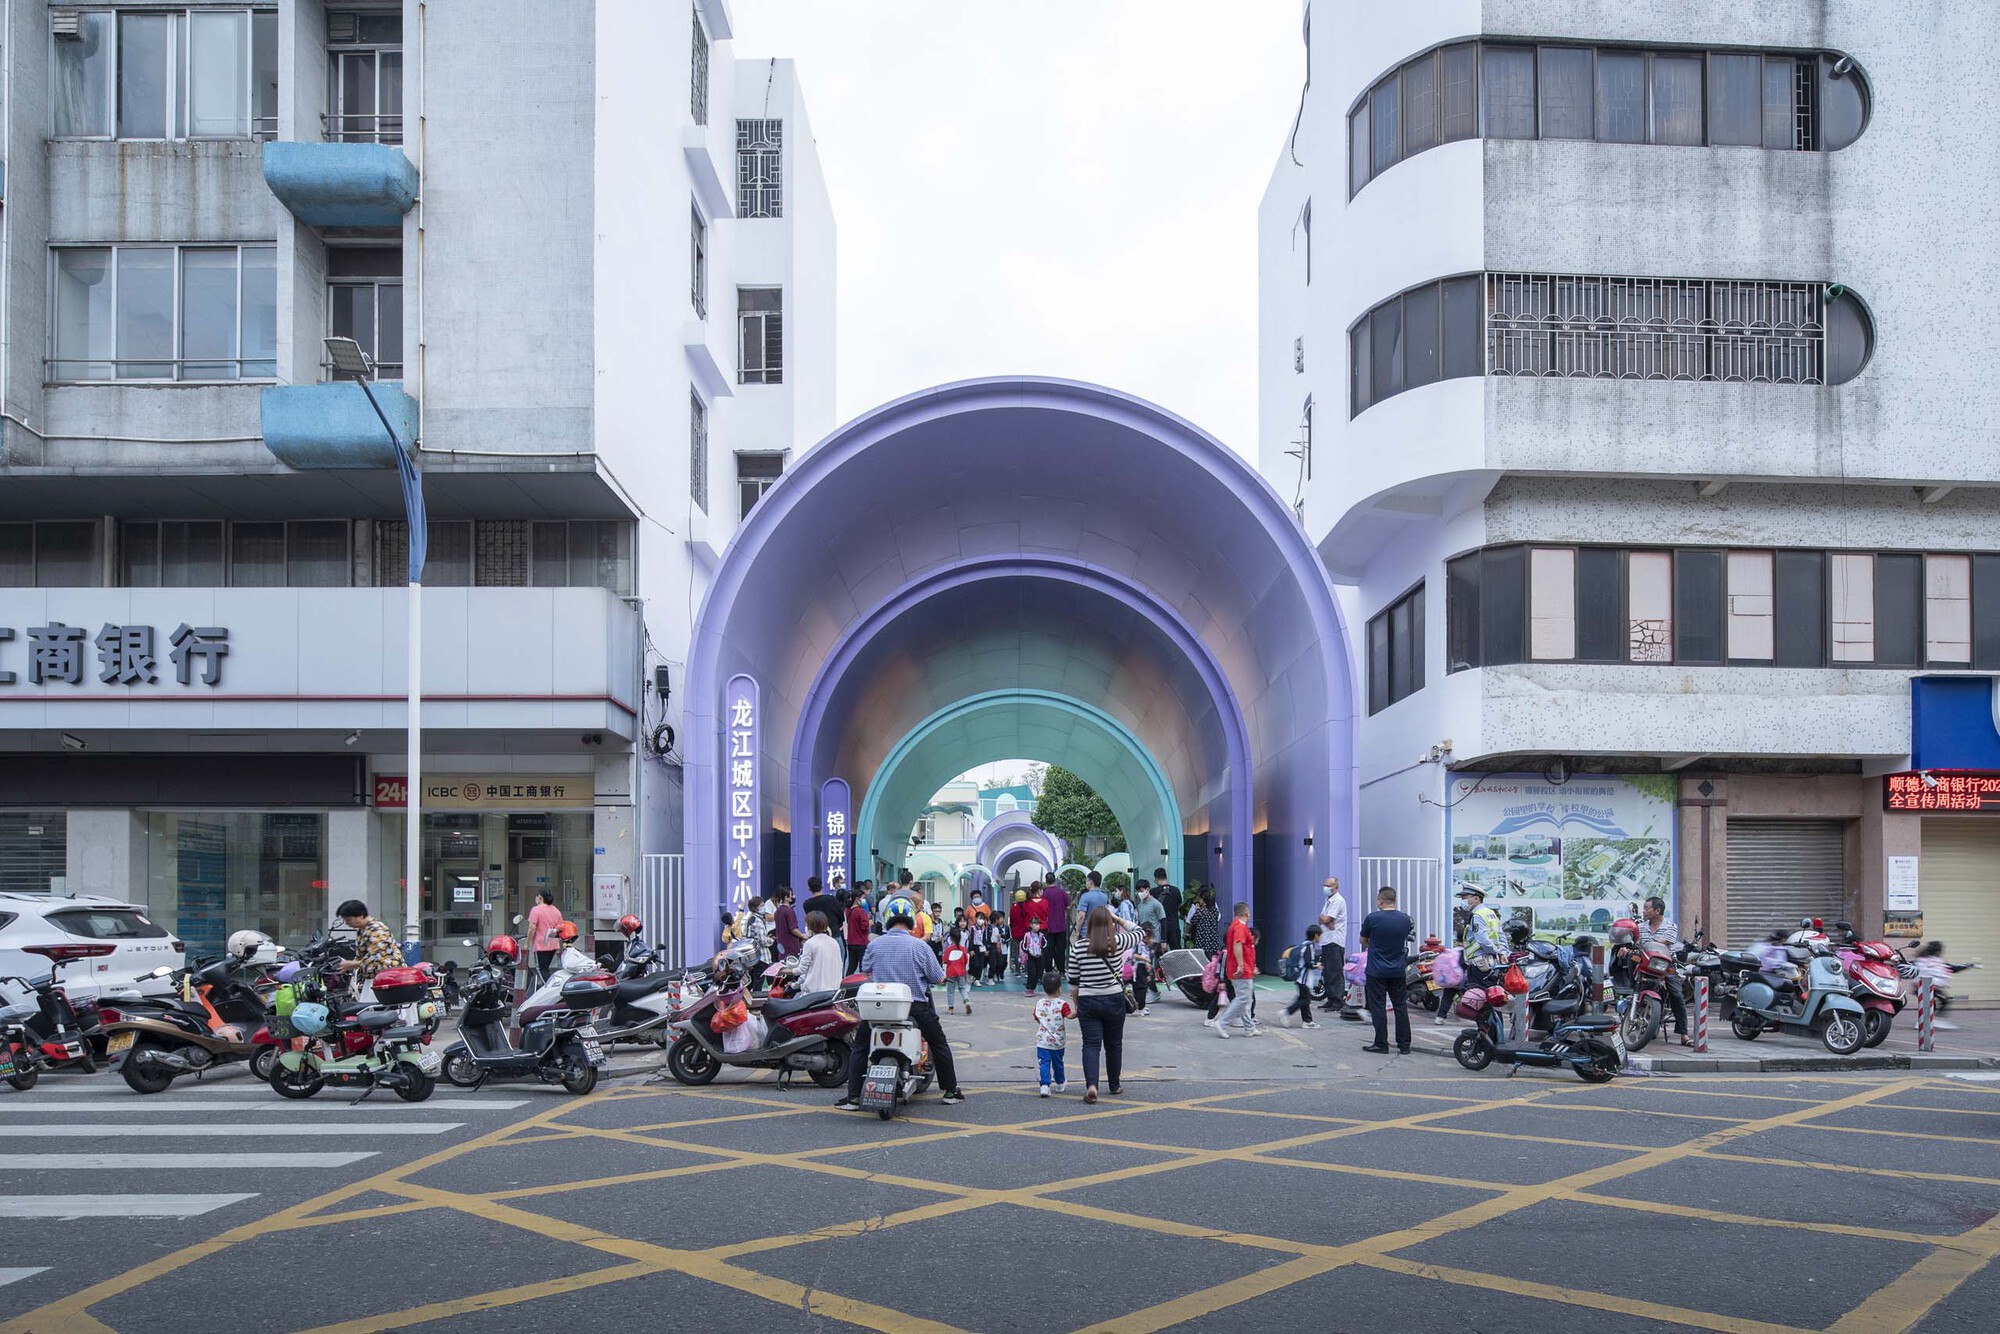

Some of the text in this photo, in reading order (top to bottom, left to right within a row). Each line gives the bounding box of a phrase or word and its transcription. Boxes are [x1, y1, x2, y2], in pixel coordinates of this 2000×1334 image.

[428, 786, 458, 797] ICBC
[487, 785, 565, 797] 中国工商银行
[731, 695, 753, 920] 龙江城区中心小
[1503, 802, 1556, 817] 公园里的学校
[1561, 803, 1615, 818] 学校里的公园
[827, 811, 845, 895] 锦屏校
